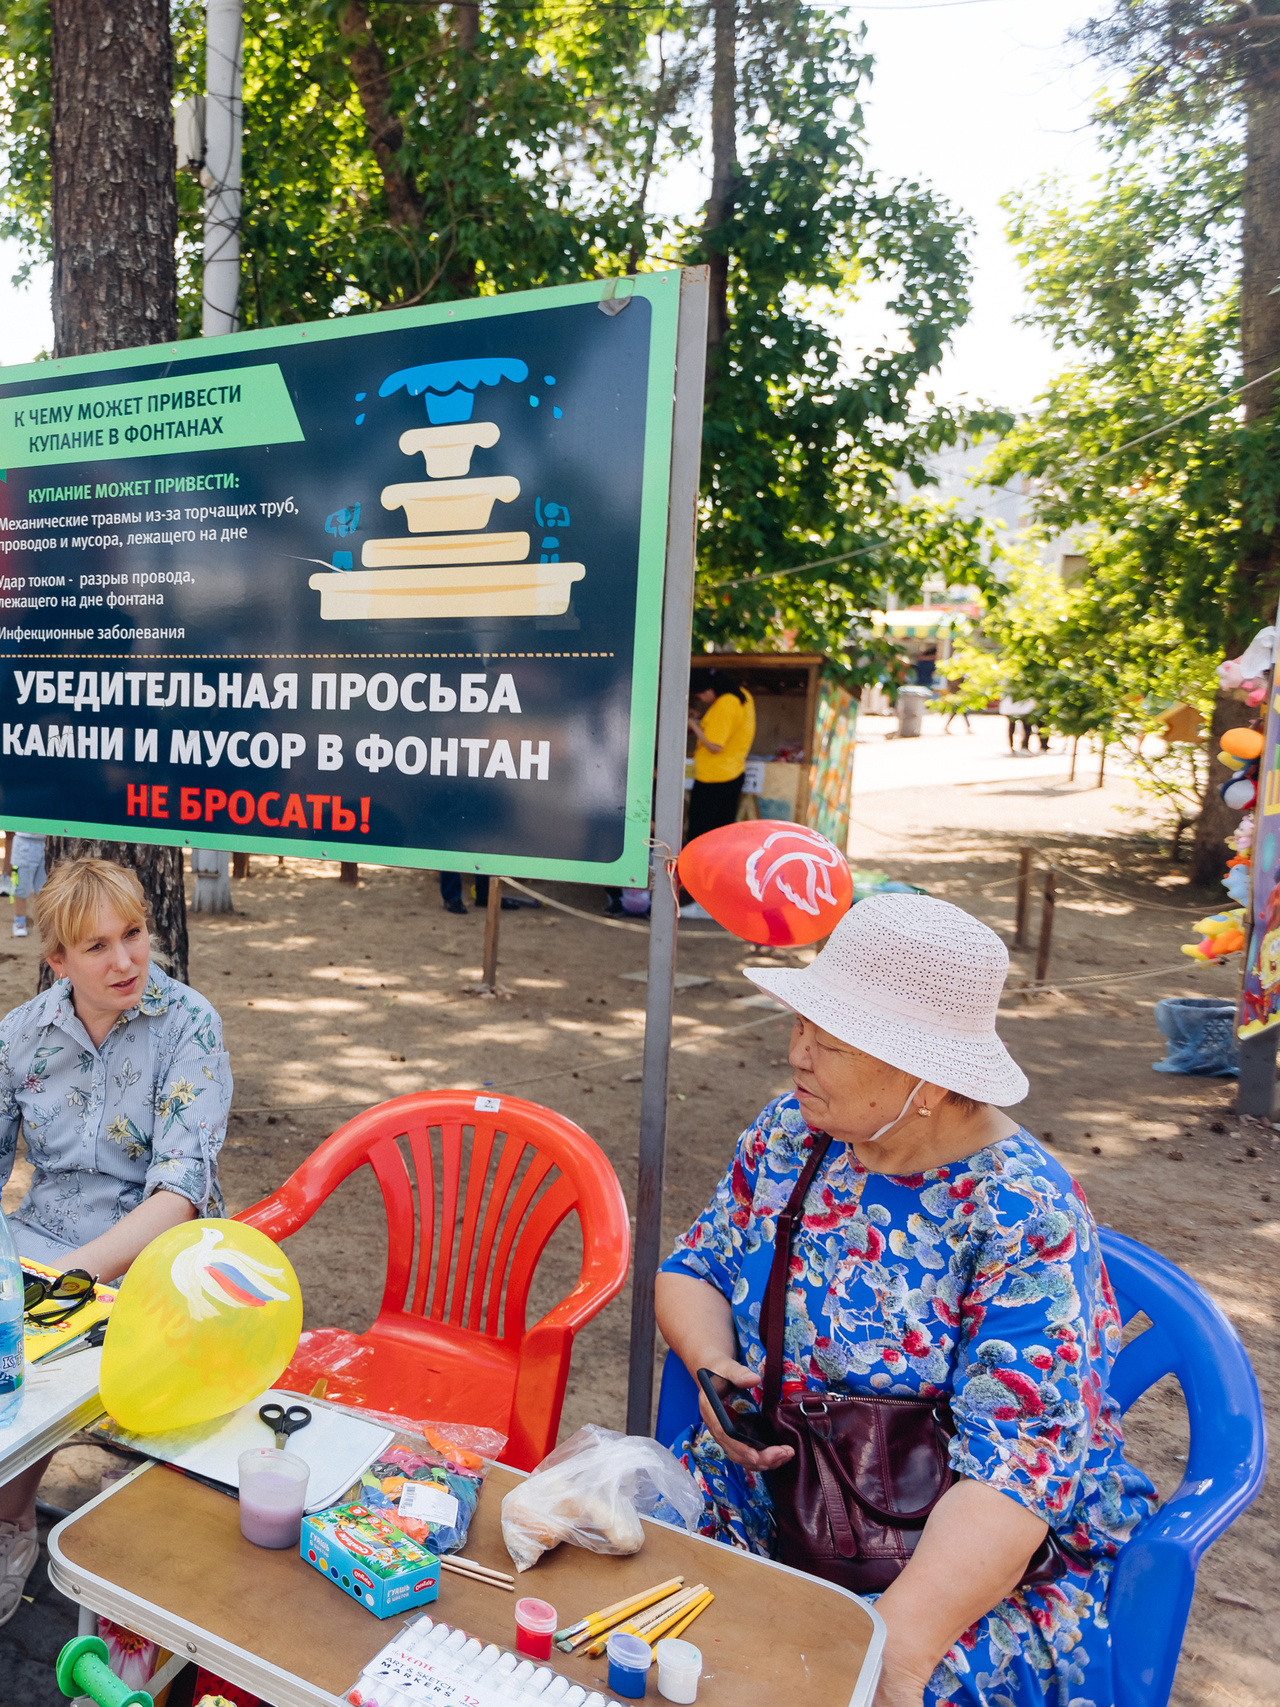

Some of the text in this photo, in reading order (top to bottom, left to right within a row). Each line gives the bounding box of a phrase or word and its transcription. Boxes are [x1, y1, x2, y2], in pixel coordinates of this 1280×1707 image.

[14, 384, 241, 428] К ЧЕМУ МОЖЕТ ПРИВЕСТИ
[29, 416, 224, 453] КУПАНИЕ В ФОНТАНАХ
[28, 473, 240, 503] КУПАНИЕ МОЖЕТ ПРИВЕСТИ:
[91, 511, 142, 529] травмы
[145, 509, 181, 522] из-за
[184, 503, 257, 523] торчащих
[260, 496, 299, 518] труб,
[60, 537, 68, 548] и
[71, 534, 123, 551] мусора,
[127, 530, 196, 545] лежащего
[200, 529, 217, 541] на
[220, 527, 248, 542] дне
[28, 576, 65, 587] током
[79, 573, 128, 589] разрыв
[132, 571, 196, 587] провода,
[61, 596, 76, 607] на
[79, 595, 103, 608] дне
[106, 591, 164, 609] фонтана
[97, 624, 185, 640] заболевания
[13, 670, 522, 713] УБЕДИТЕЛЬНАЯ ПРОСЬБА
[3, 723, 550, 781] КАМНИ И МУСОР В ФОНТАН
[127, 783, 371, 834] НЕ БРОСАТЬ!
[387, 1584, 410, 1598] ГУАШЬ
[381, 1661, 452, 1697] MARKERS
[385, 1657, 406, 1669] ART
[415, 1671, 457, 1693] SKETCH
